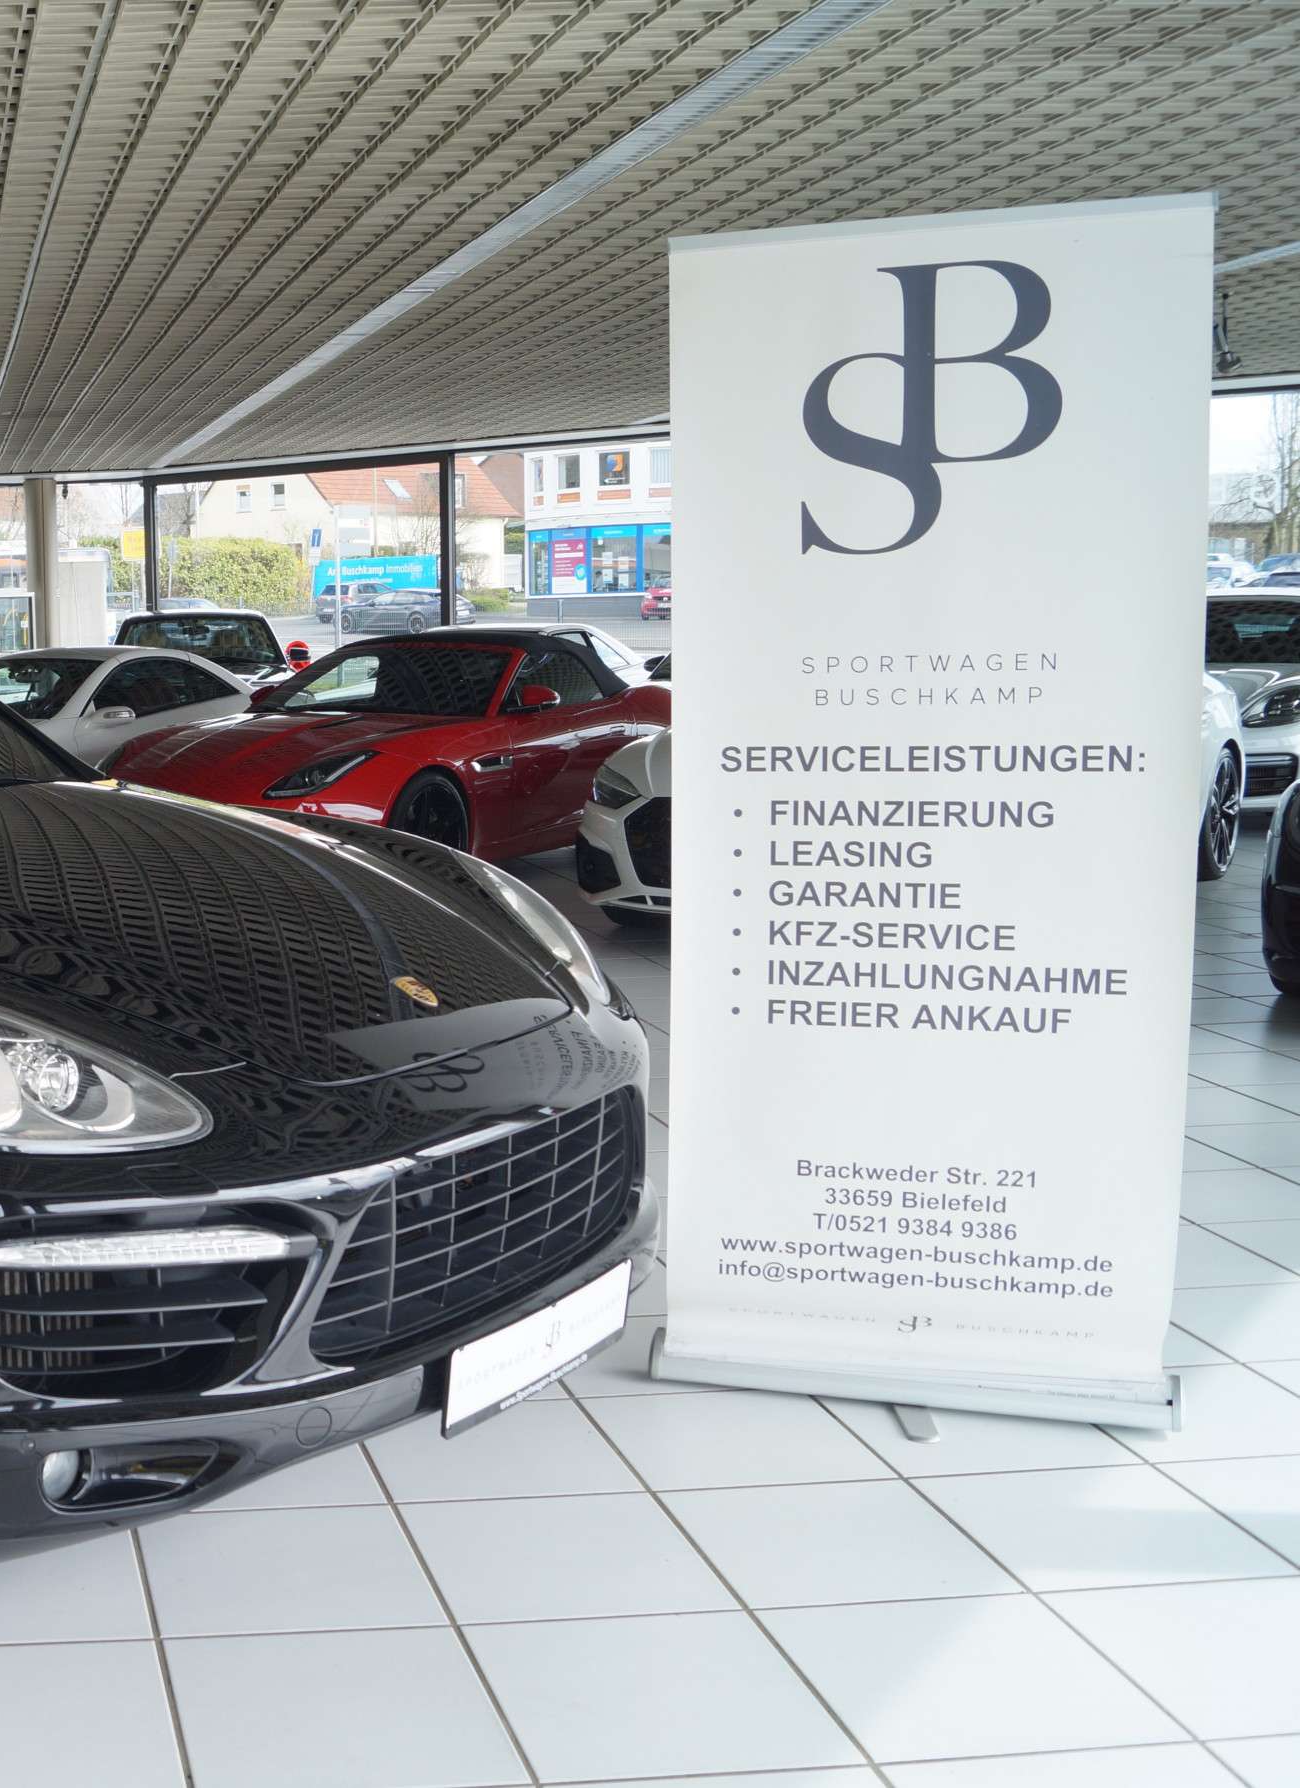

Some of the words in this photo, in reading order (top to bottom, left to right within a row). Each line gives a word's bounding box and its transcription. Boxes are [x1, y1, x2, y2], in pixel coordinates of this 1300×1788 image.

[801, 652, 1057, 675] SPORTWAGEN
[814, 686, 1043, 707] BUSCHKAMP
[720, 744, 1146, 774] SERVICELEISTUNGEN:
[769, 799, 1055, 829] FINANZIERUNG
[769, 839, 933, 869] LEASING
[768, 879, 962, 910] GARANTIE
[768, 919, 1016, 952] KFZ-SERVICE
[767, 959, 1128, 996] INZAHLUNGNAHME
[767, 998, 901, 1030] FREIER
[910, 1003, 1073, 1034] ANKAUF
[796, 1159, 940, 1184] Brackweder
[946, 1166, 988, 1187] Str.
[995, 1169, 1038, 1189] 221
[824, 1186, 893, 1209] 33659
[901, 1190, 1007, 1214] Bielefeld
[812, 1212, 888, 1234] T/0521
[897, 1216, 954, 1238] 9384
[960, 1220, 1018, 1241] 9386
[720, 1236, 1113, 1275] www.sportwagen-buschkamp.de
[718, 1258, 1114, 1300] info@sportwagen-buschkamp.de
